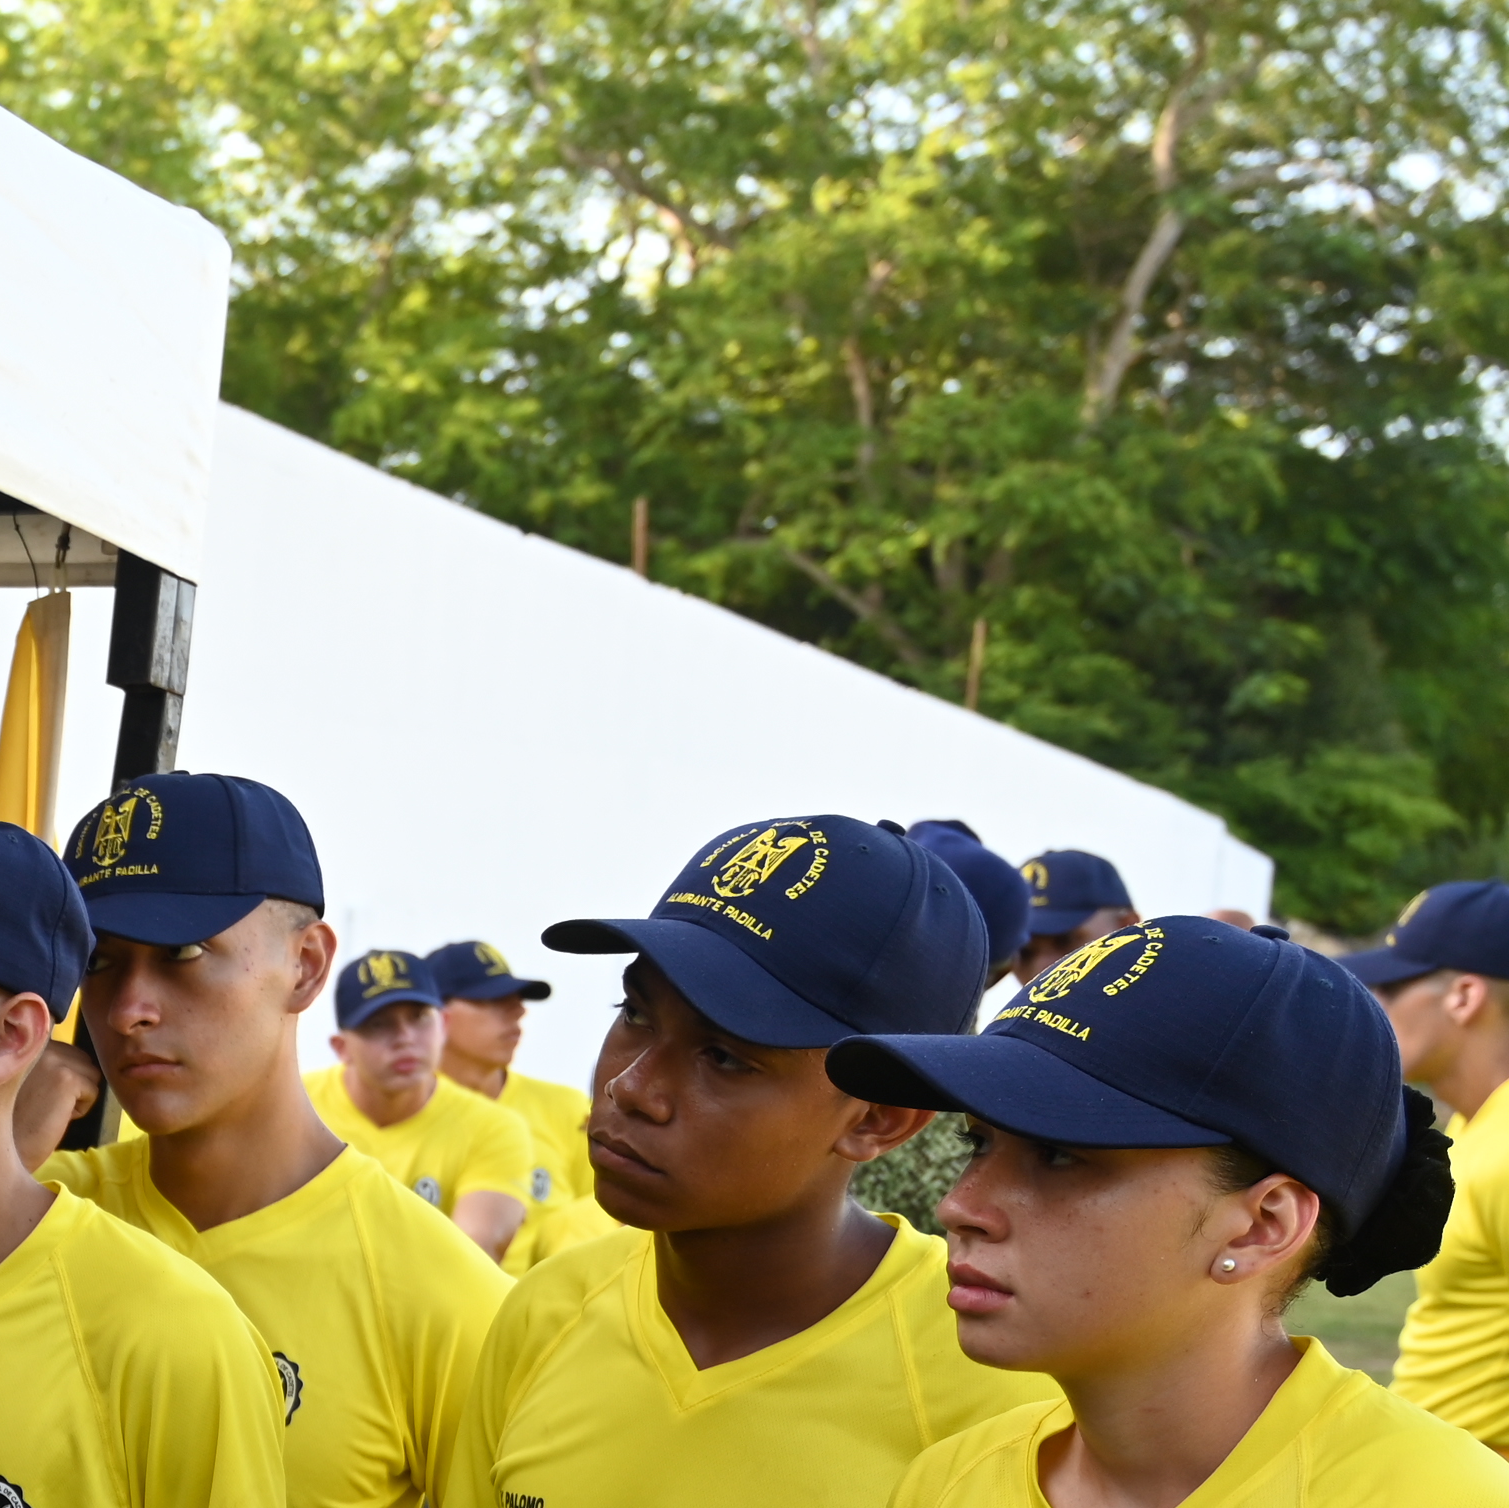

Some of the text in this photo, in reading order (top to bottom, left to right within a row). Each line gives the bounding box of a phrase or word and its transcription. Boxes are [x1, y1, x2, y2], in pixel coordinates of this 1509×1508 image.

[146, 796, 162, 839] CADETES
[809, 830, 827, 844] DE
[115, 864, 159, 877] PADILLA
[785, 848, 829, 900] CADETES
[723, 905, 773, 940] PADILLA
[1144, 927, 1165, 940] DE
[1103, 942, 1163, 996] CADETES
[1034, 1009, 1091, 1042] PADILLA
